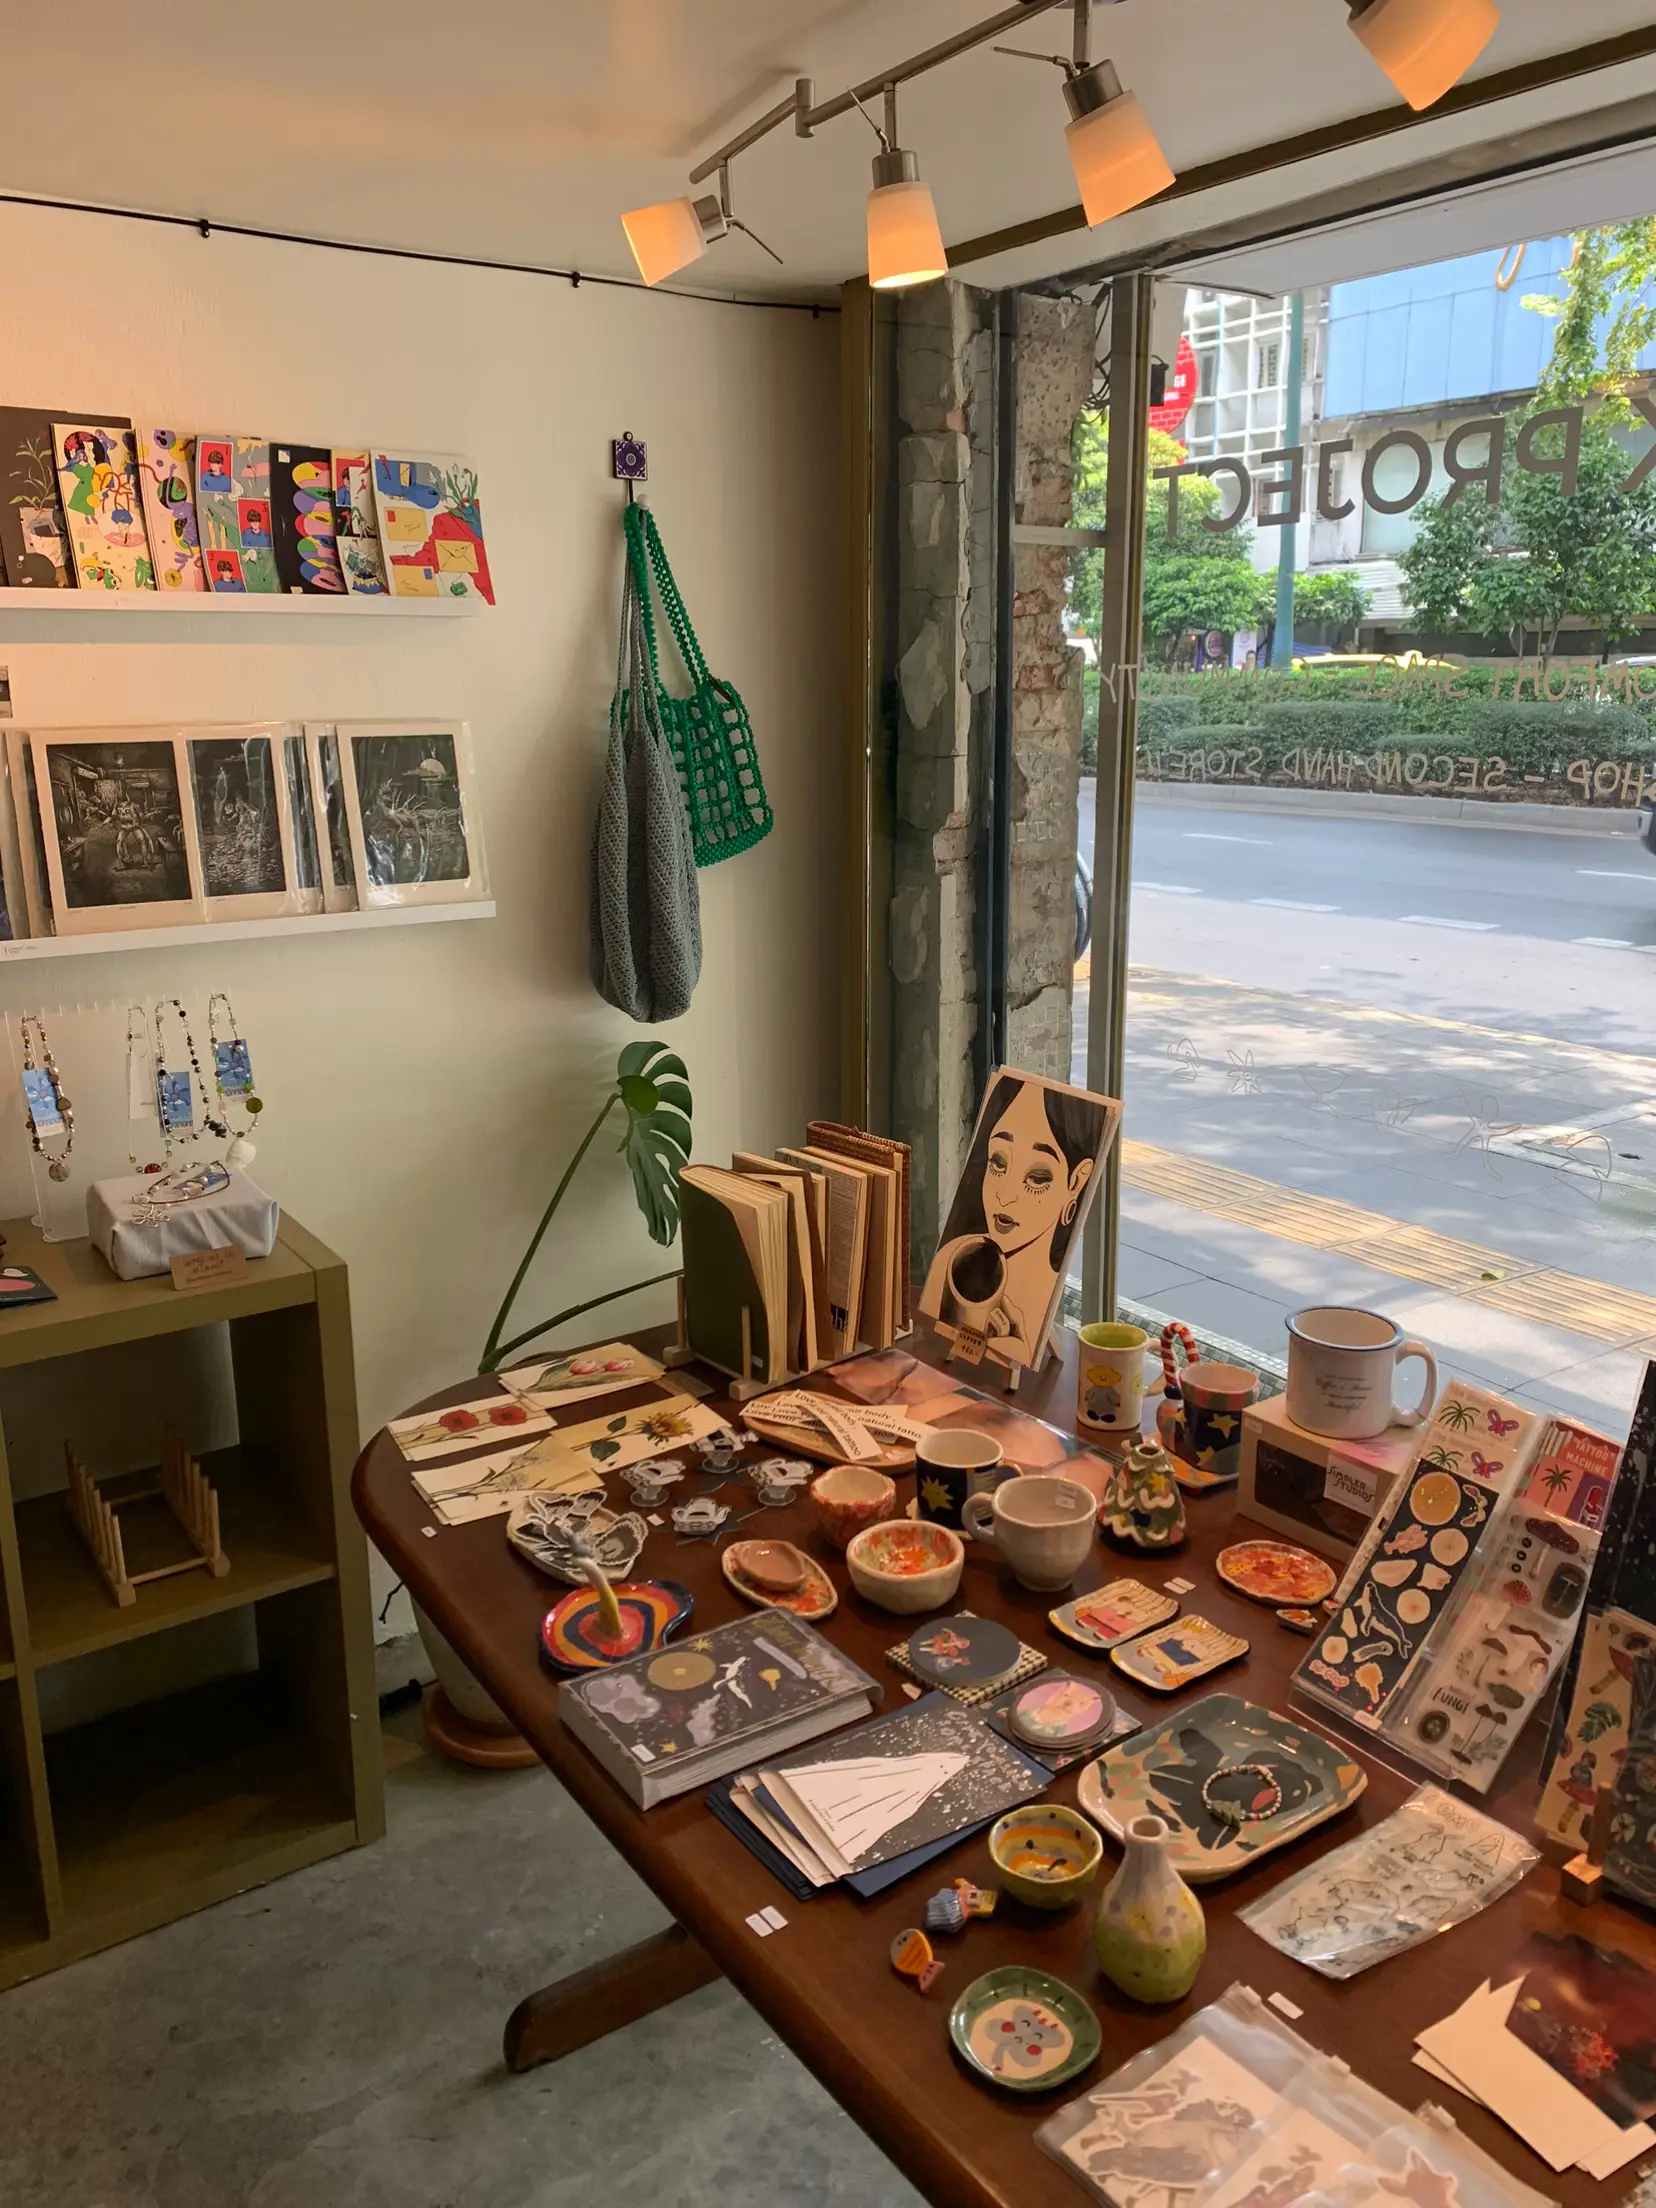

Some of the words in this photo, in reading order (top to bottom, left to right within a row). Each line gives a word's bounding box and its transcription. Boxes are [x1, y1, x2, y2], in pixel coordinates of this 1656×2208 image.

[1573, 1438, 1609, 1462] TATTOO
[1564, 1451, 1609, 1478] MACHINE
[1327, 1465, 1368, 1490] SIMPLER
[1332, 1478, 1375, 1503] STUDIOS
